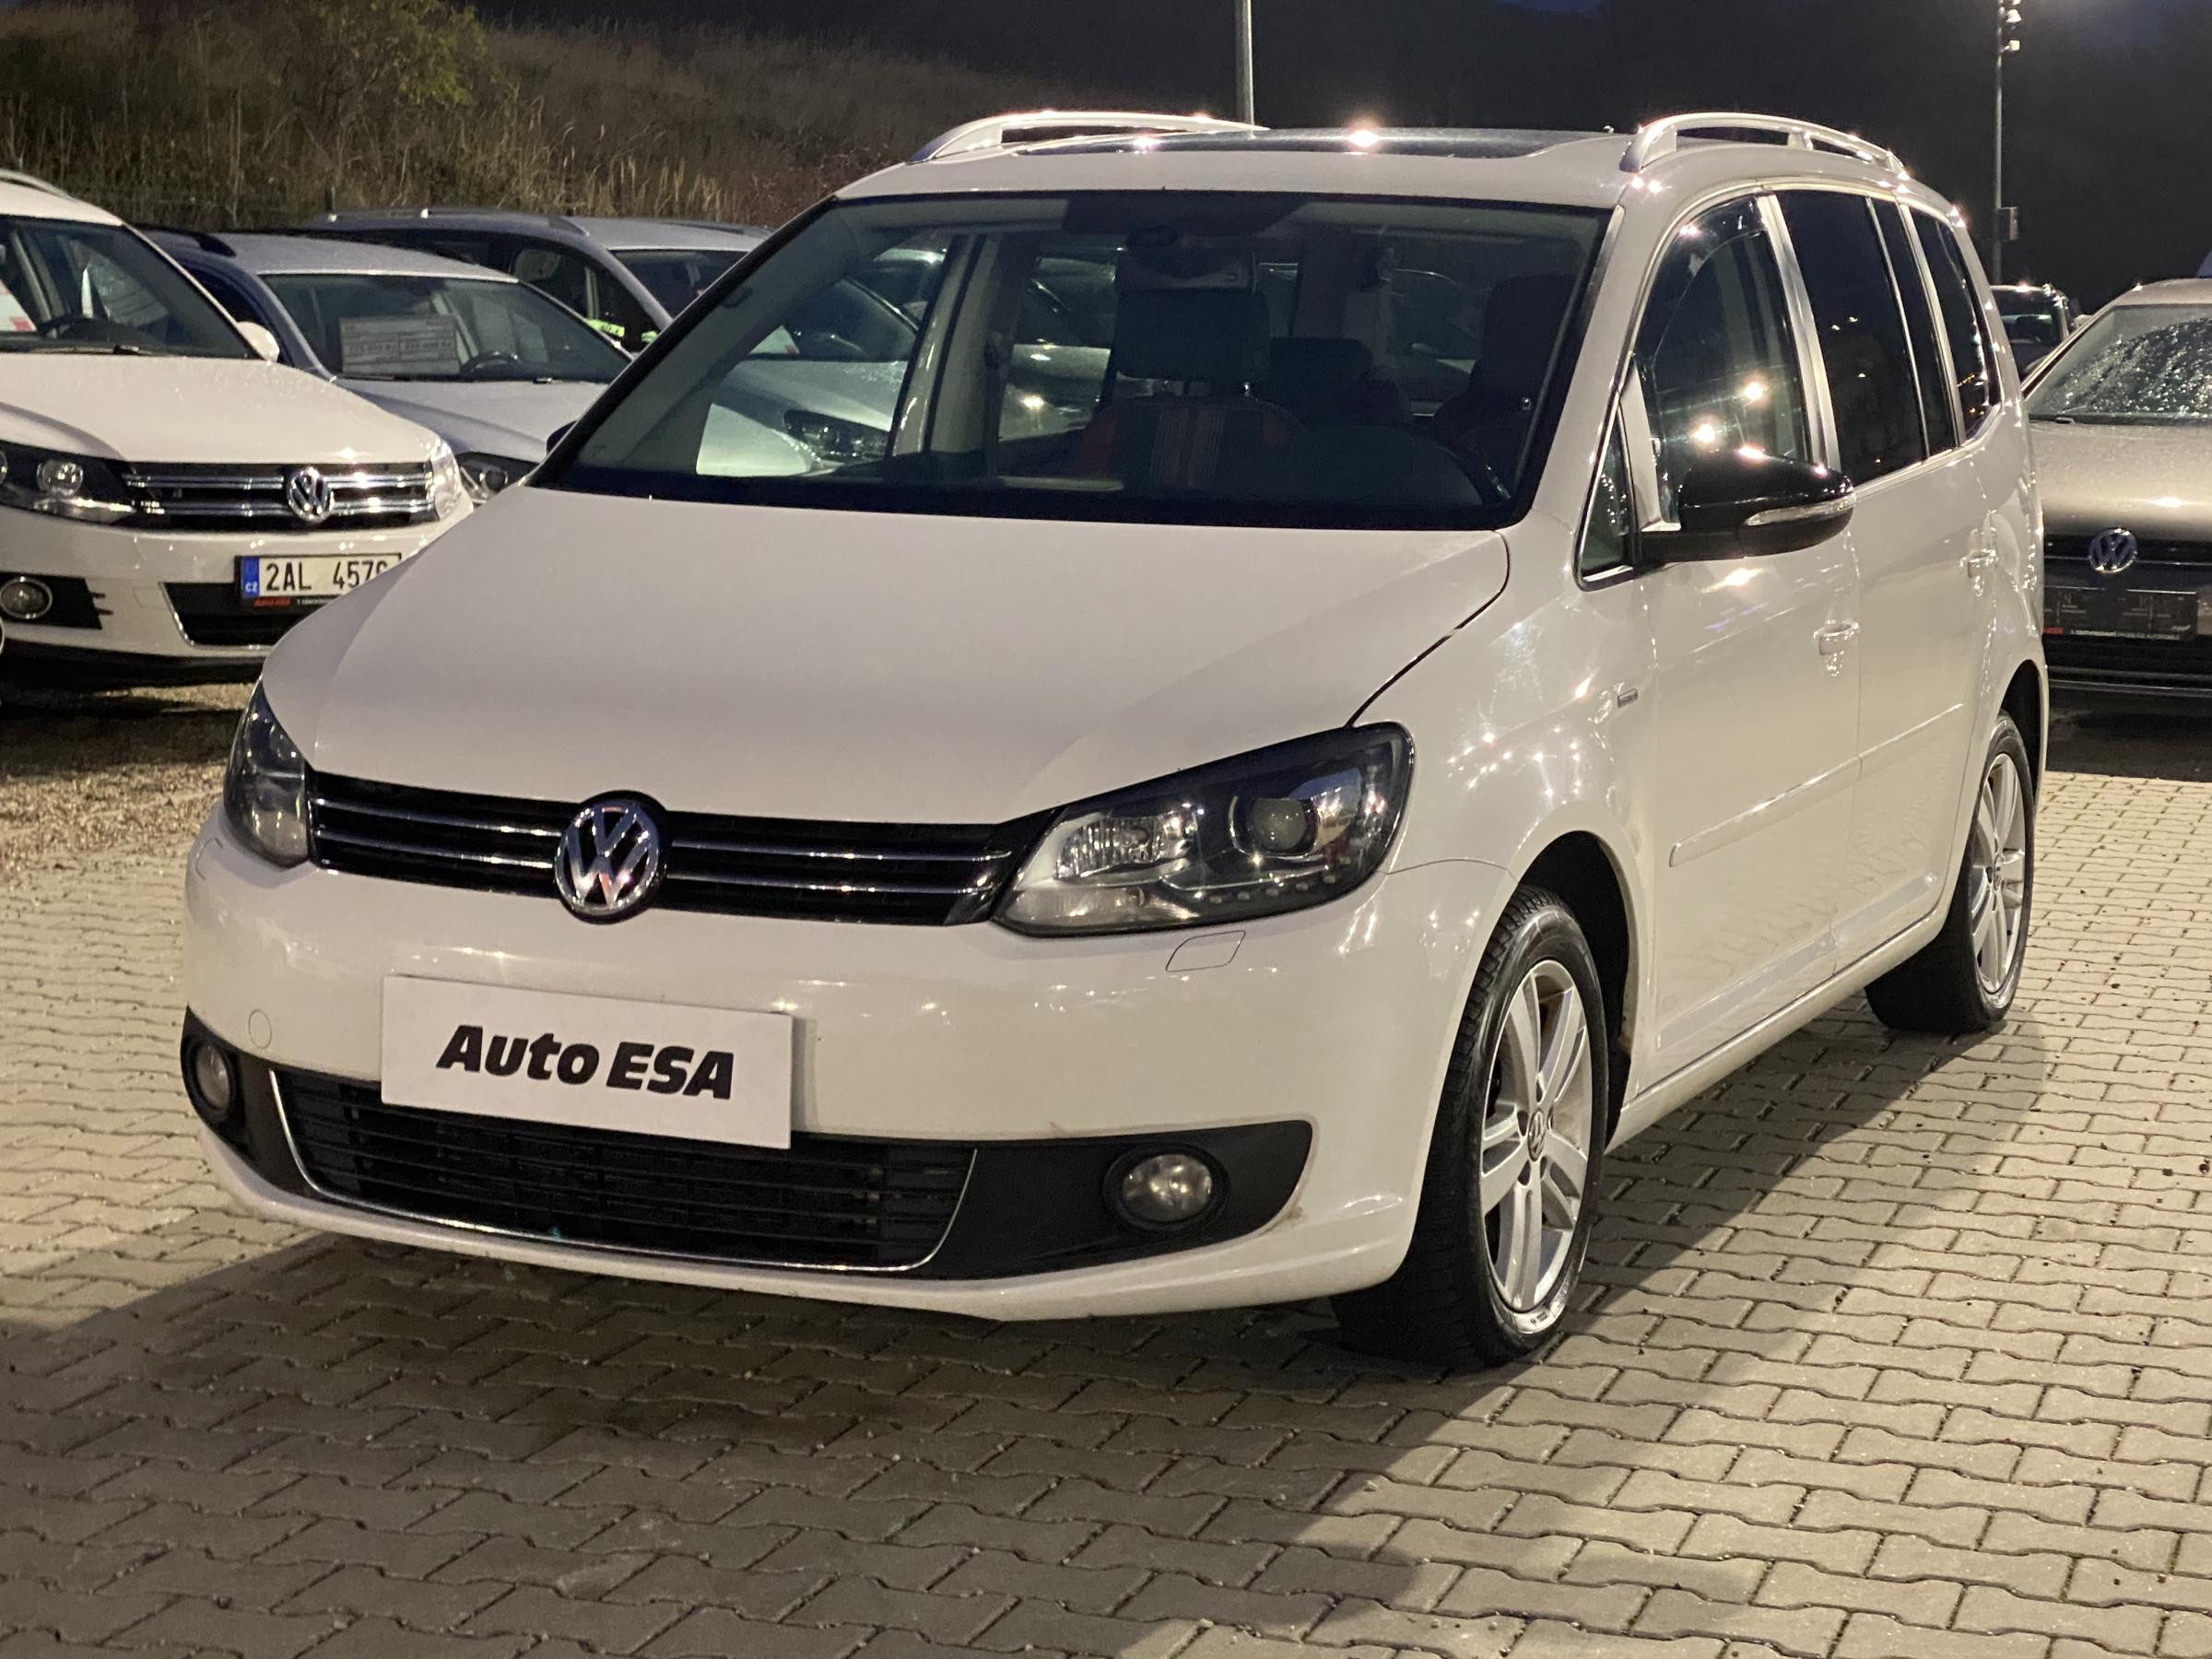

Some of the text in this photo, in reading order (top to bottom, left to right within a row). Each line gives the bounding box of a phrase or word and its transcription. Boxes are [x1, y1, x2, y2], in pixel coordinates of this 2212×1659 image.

[265, 561, 312, 591] 2AL
[436, 1025, 735, 1100] Auto ESA
